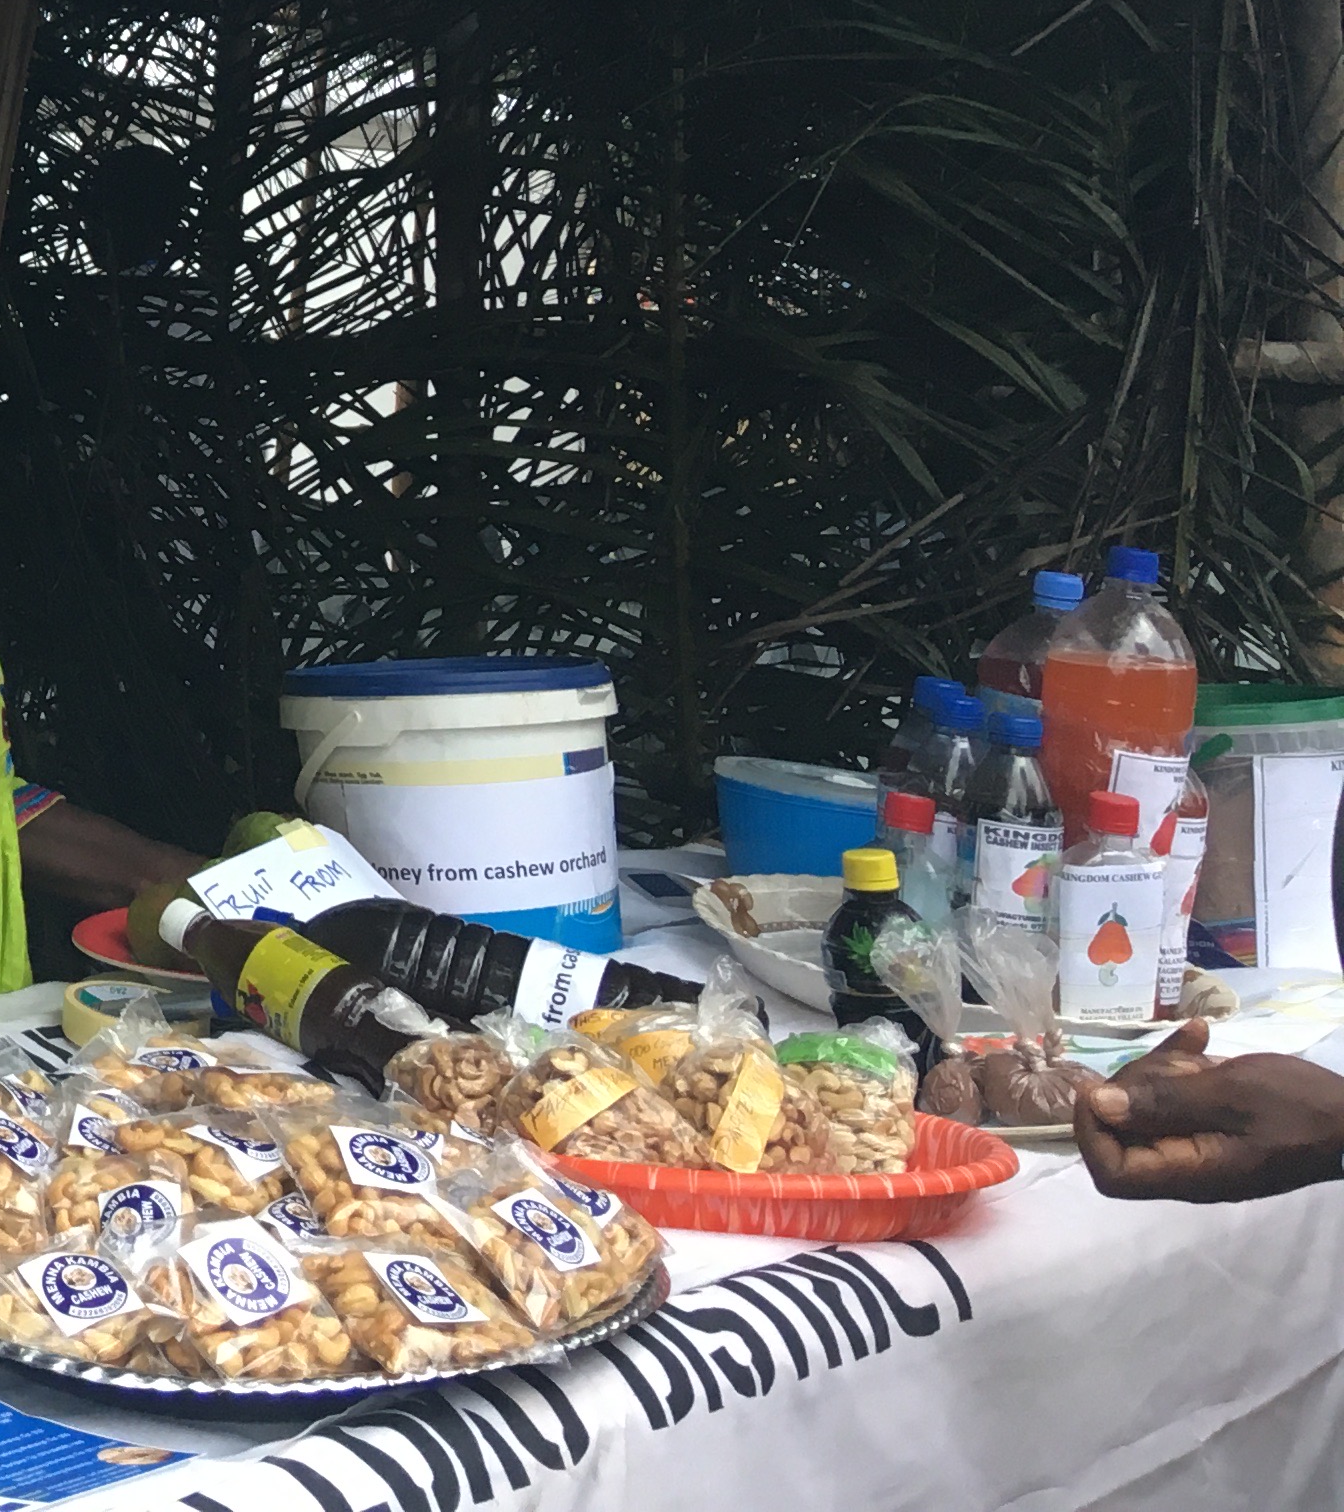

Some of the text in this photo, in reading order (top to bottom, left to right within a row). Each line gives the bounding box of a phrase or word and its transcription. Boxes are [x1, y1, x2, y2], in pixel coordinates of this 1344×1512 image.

[986, 835, 1029, 850] CASHEW
[372, 846, 607, 886] oney from cashew orchard
[1061, 871, 1151, 883] KINGDOM CASHEW
[204, 858, 352, 920] FRUIT FROM
[542, 969, 571, 1026] from
[351, 1133, 408, 1182] MENNA KAMBIA
[514, 1199, 572, 1243] MENNA KAMBIA
[45, 1261, 65, 1306] MENNA
[65, 1256, 119, 1284] KAMBIA
[209, 1242, 279, 1311] MENNA KAMBIA
[238, 1251, 276, 1291] CASHEW
[388, 1262, 456, 1299] MENNA KAMBIA
[70, 1284, 113, 1305] CASHEW
[596, 1239, 974, 1429] DISTRICT
